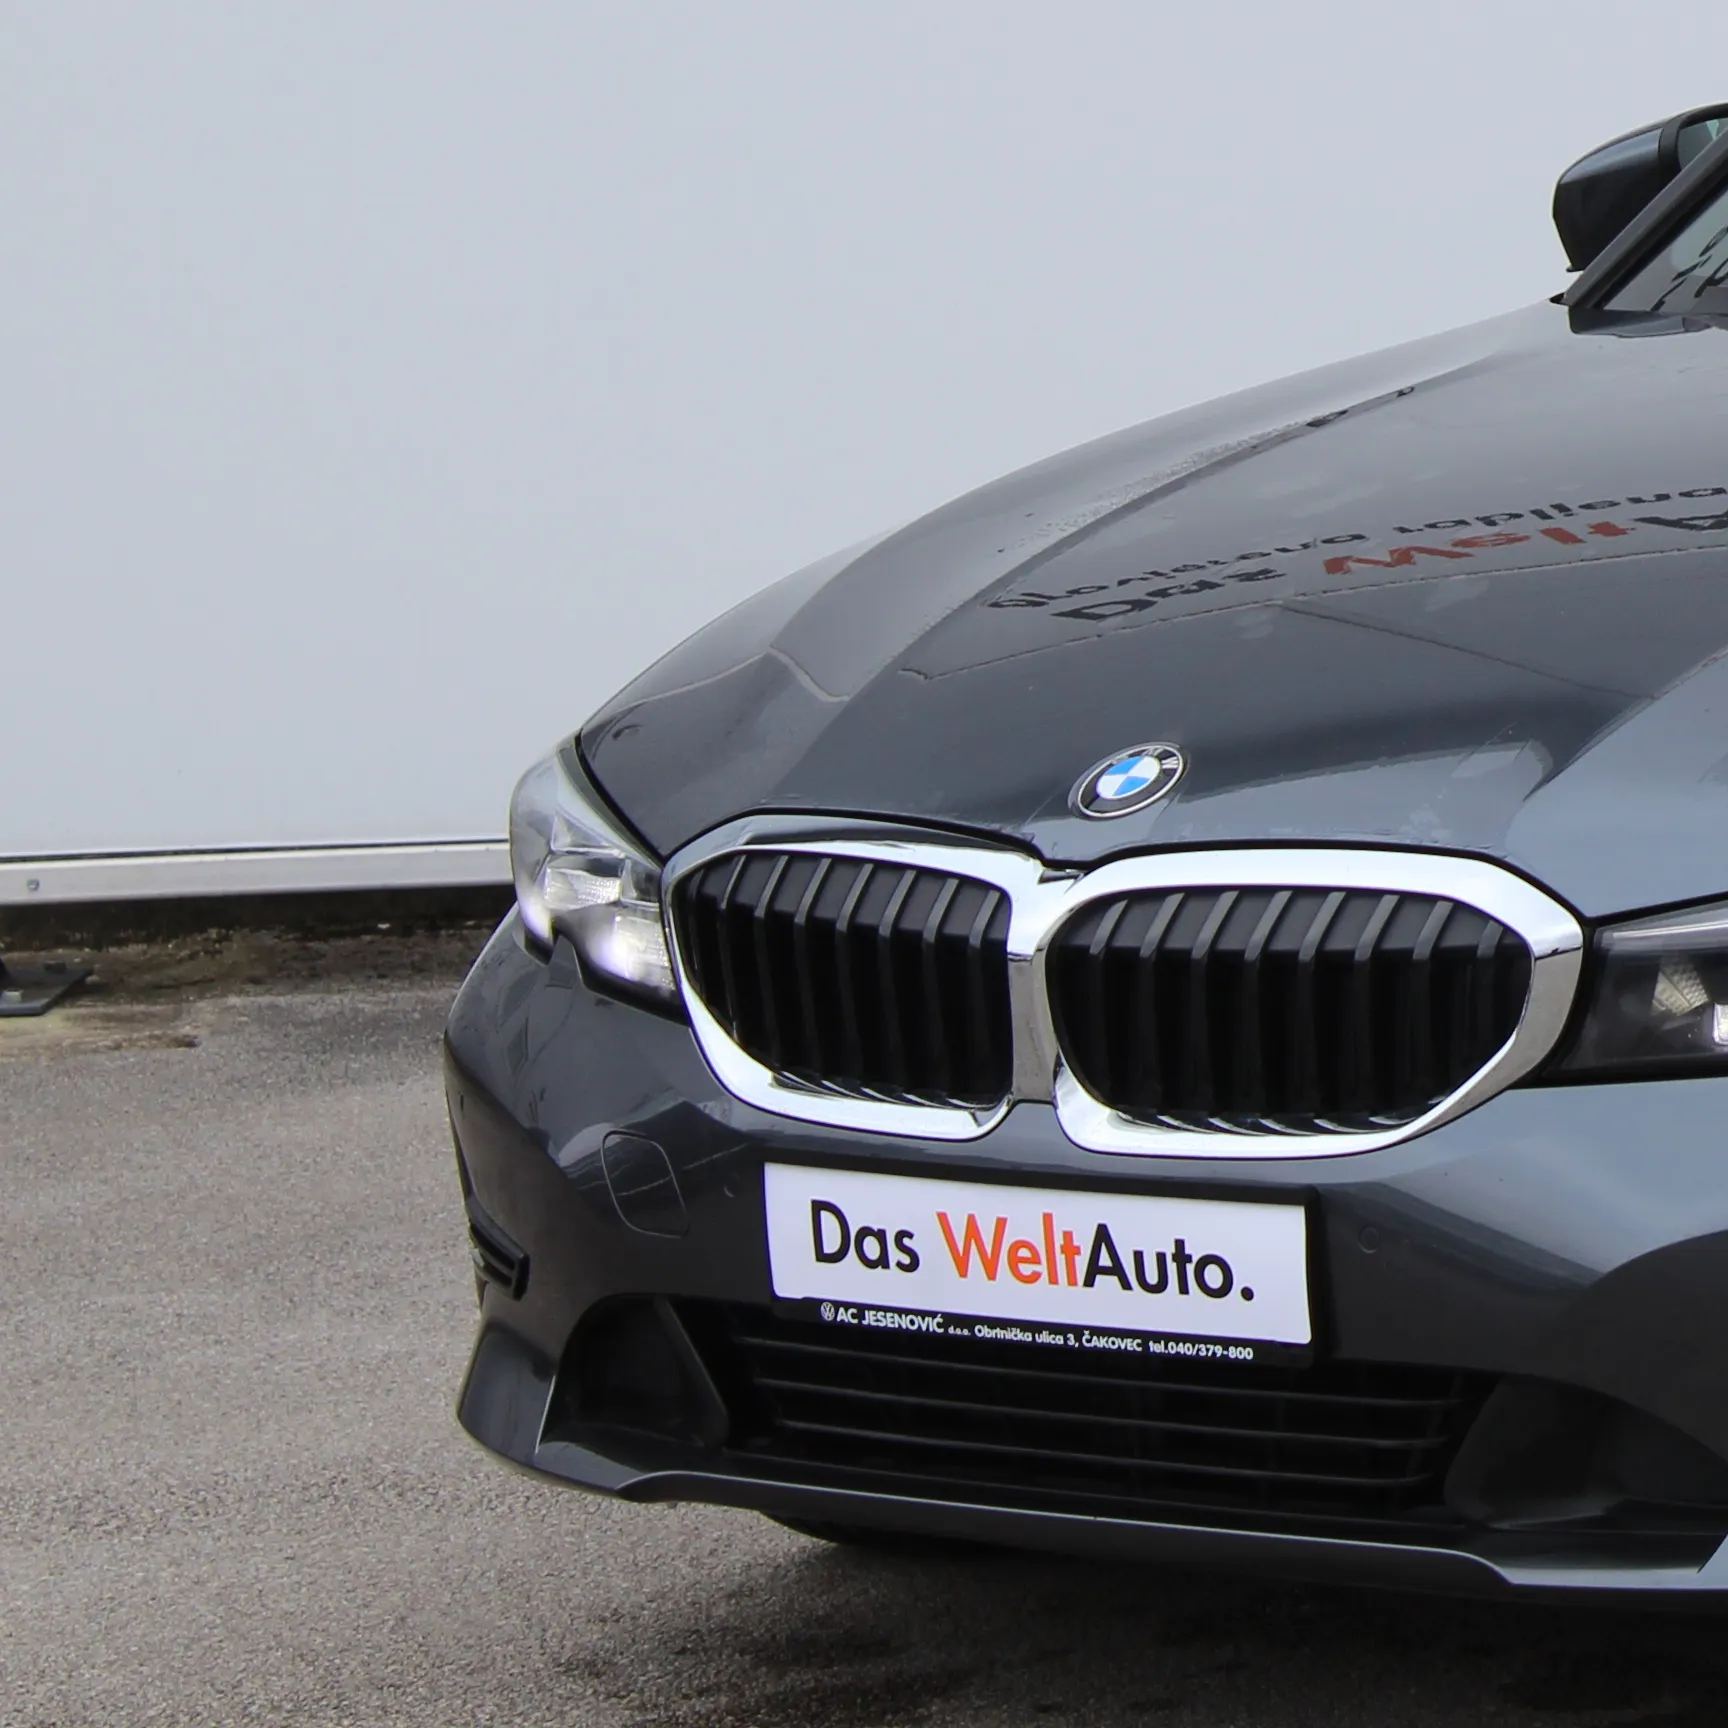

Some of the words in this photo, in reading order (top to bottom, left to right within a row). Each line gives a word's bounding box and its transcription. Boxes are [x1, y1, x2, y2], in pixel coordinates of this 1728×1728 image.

[811, 1200, 920, 1273] Das
[936, 1212, 1255, 1302] WeltAuto.
[837, 1307, 858, 1323] AC
[862, 1310, 944, 1333] JESENOVIĆ
[974, 1325, 1032, 1342] Obrtnička
[1035, 1330, 1064, 1345] ulica
[1081, 1330, 1142, 1351] ČAKOVEC
[1148, 1340, 1254, 1360] tel.040/379-800
